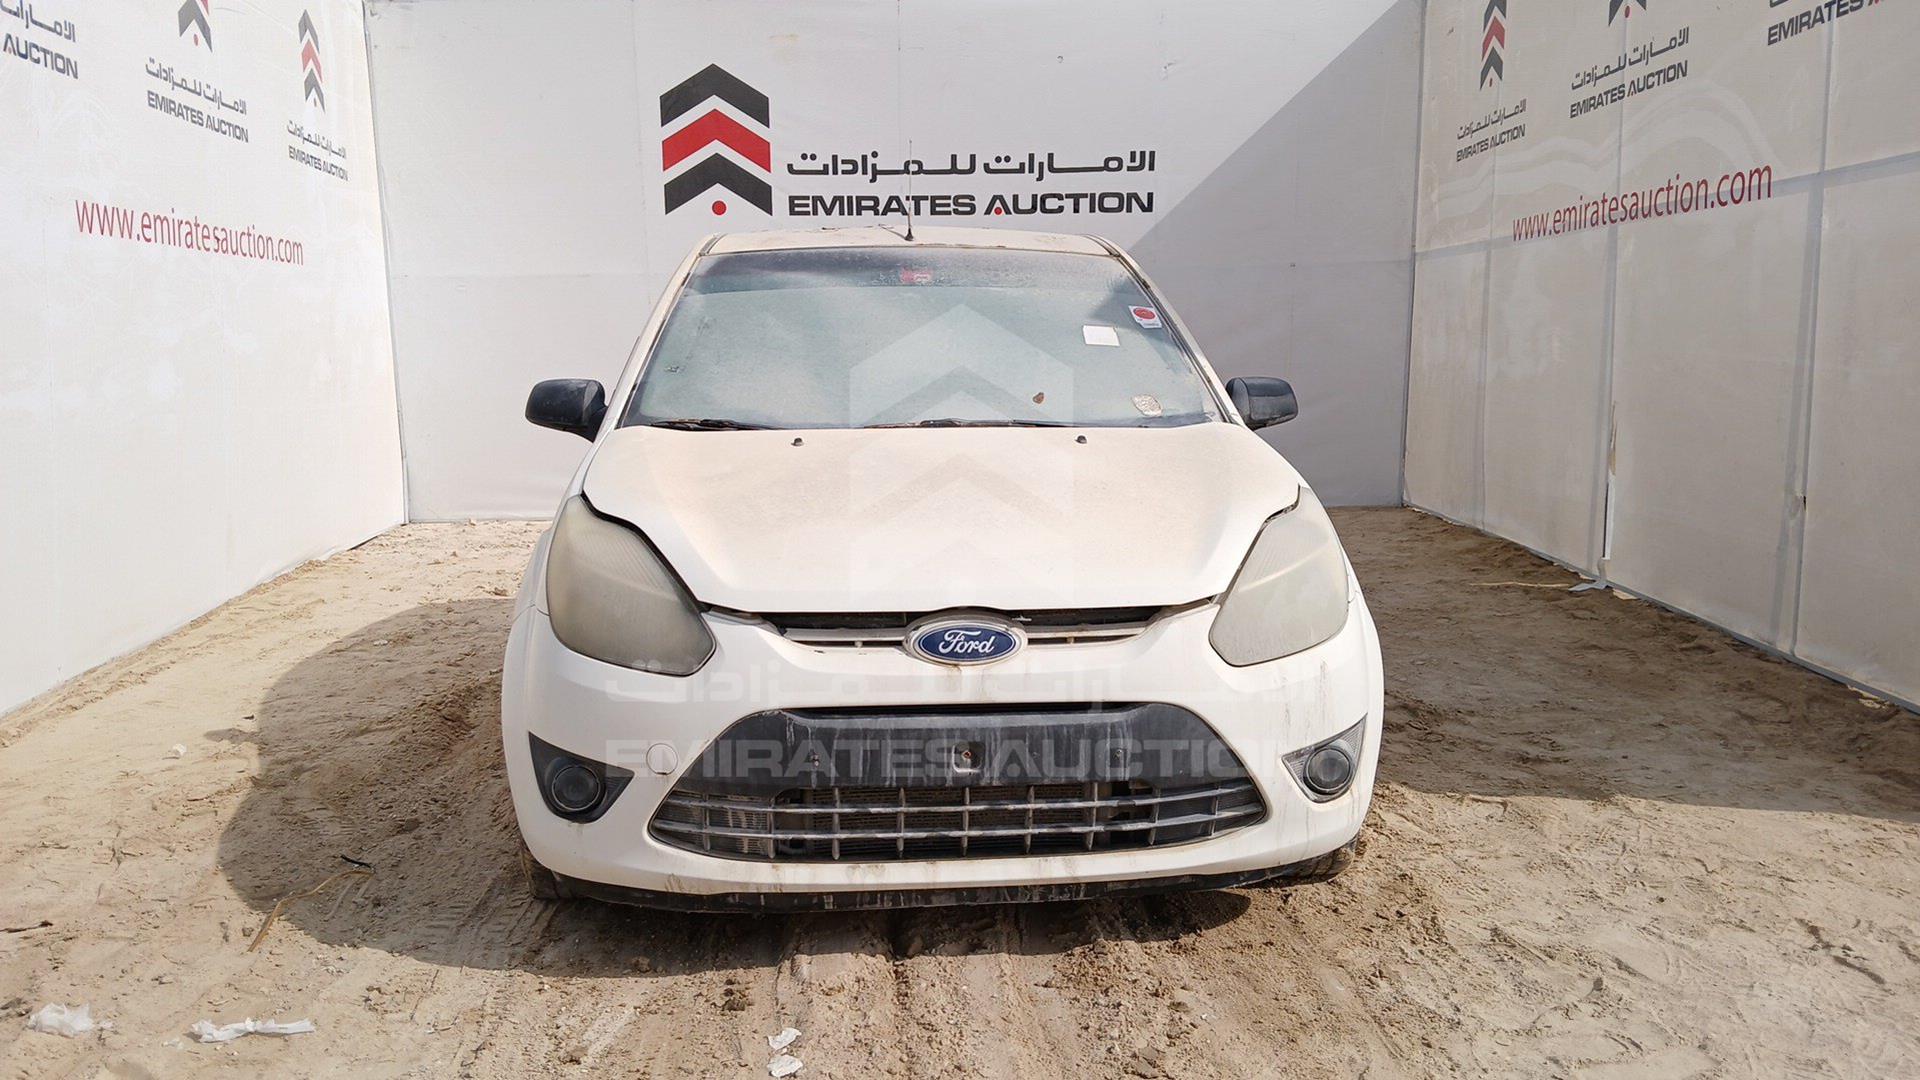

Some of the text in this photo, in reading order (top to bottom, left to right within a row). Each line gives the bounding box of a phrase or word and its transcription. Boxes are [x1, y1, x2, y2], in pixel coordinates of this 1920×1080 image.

[1767, 0, 1864, 46] EMIRATES
[3, 33, 79, 80] AUCTION
[1569, 60, 1688, 119] EMIRATES AUCTION
[147, 90, 249, 143] EMIRATES AUCTION
[1489, 123, 1526, 149] AUCTION
[788, 191, 1154, 217] EMIRATES AUCTION
[1511, 163, 1773, 242] www.emiratesauction.com
[75, 199, 304, 266] www.emiratesauction.com
[938, 629, 997, 654] Ford
